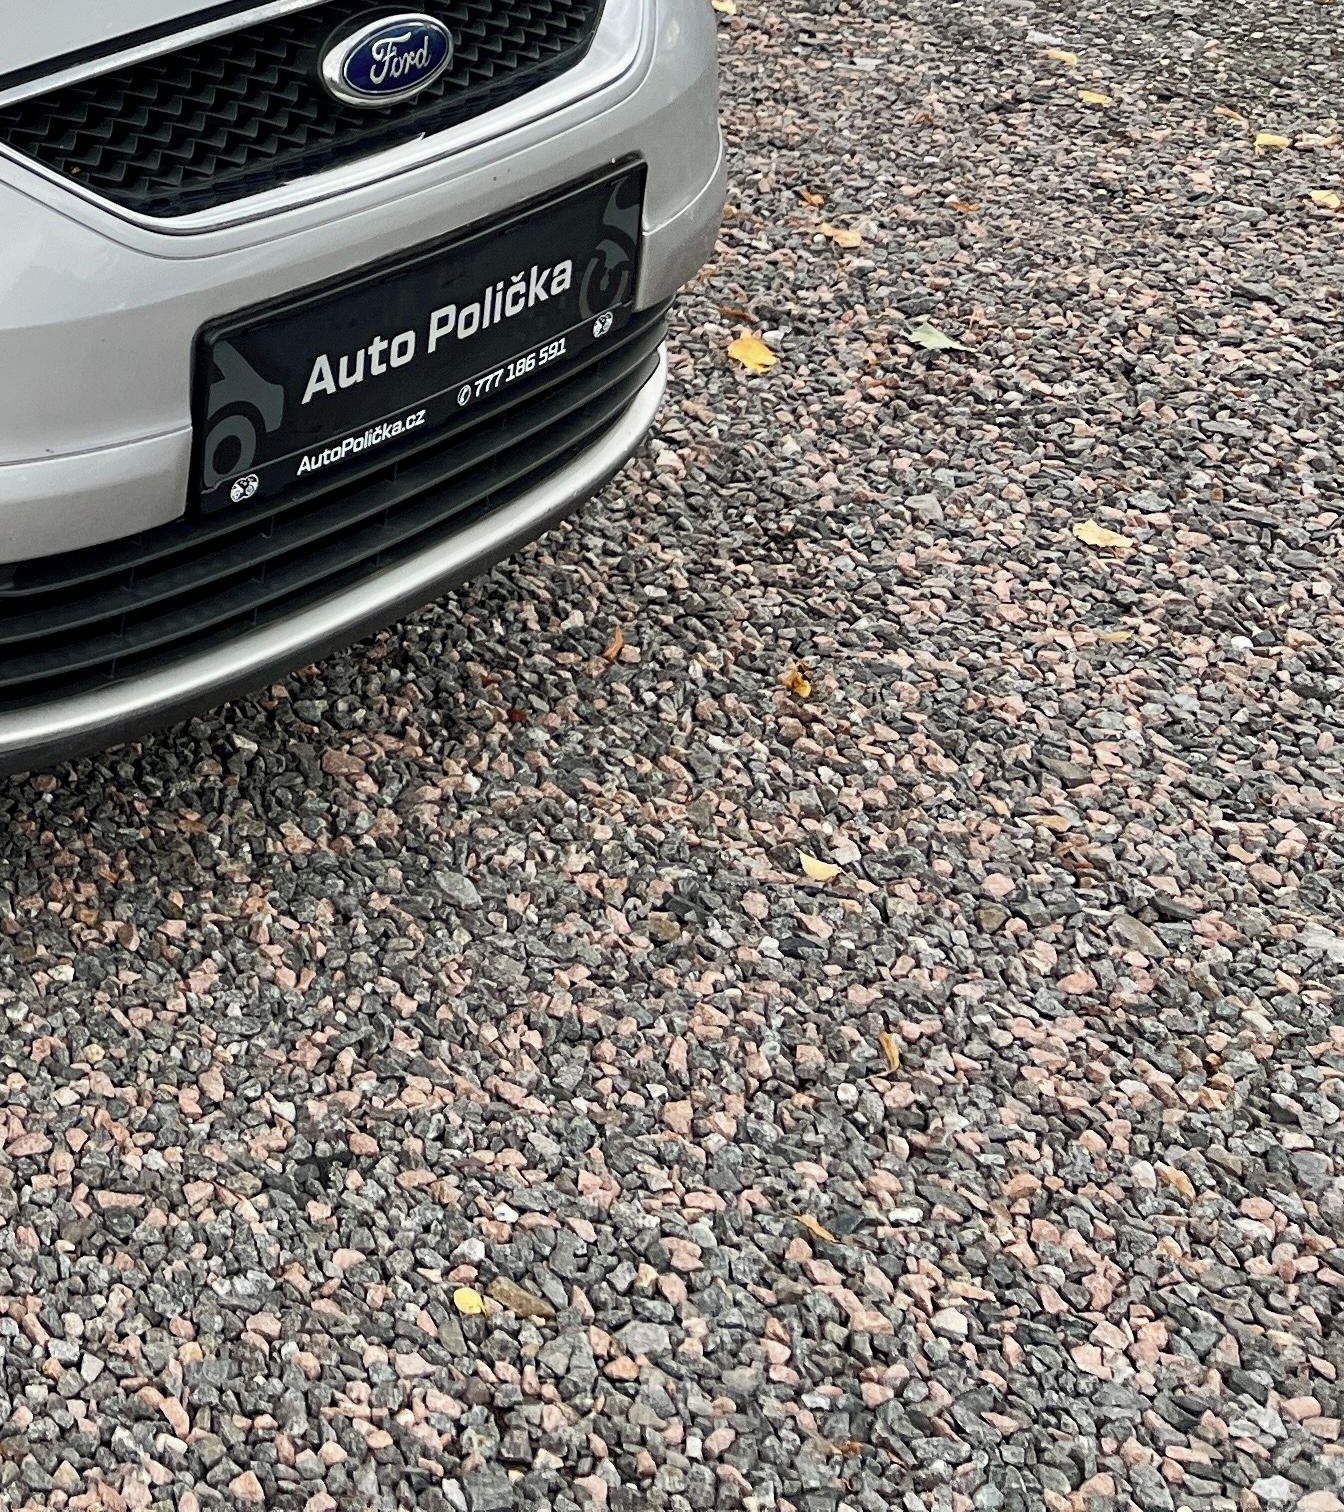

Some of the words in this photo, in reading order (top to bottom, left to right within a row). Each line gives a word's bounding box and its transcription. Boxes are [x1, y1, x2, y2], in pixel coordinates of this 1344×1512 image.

[369, 31, 432, 85] Ford
[301, 329, 416, 405] Auto
[427, 259, 573, 353] Polička
[296, 409, 426, 476] AutoPolička.cz
[474, 368, 505, 397] 777
[505, 352, 537, 383] 186
[538, 337, 567, 366] 591
